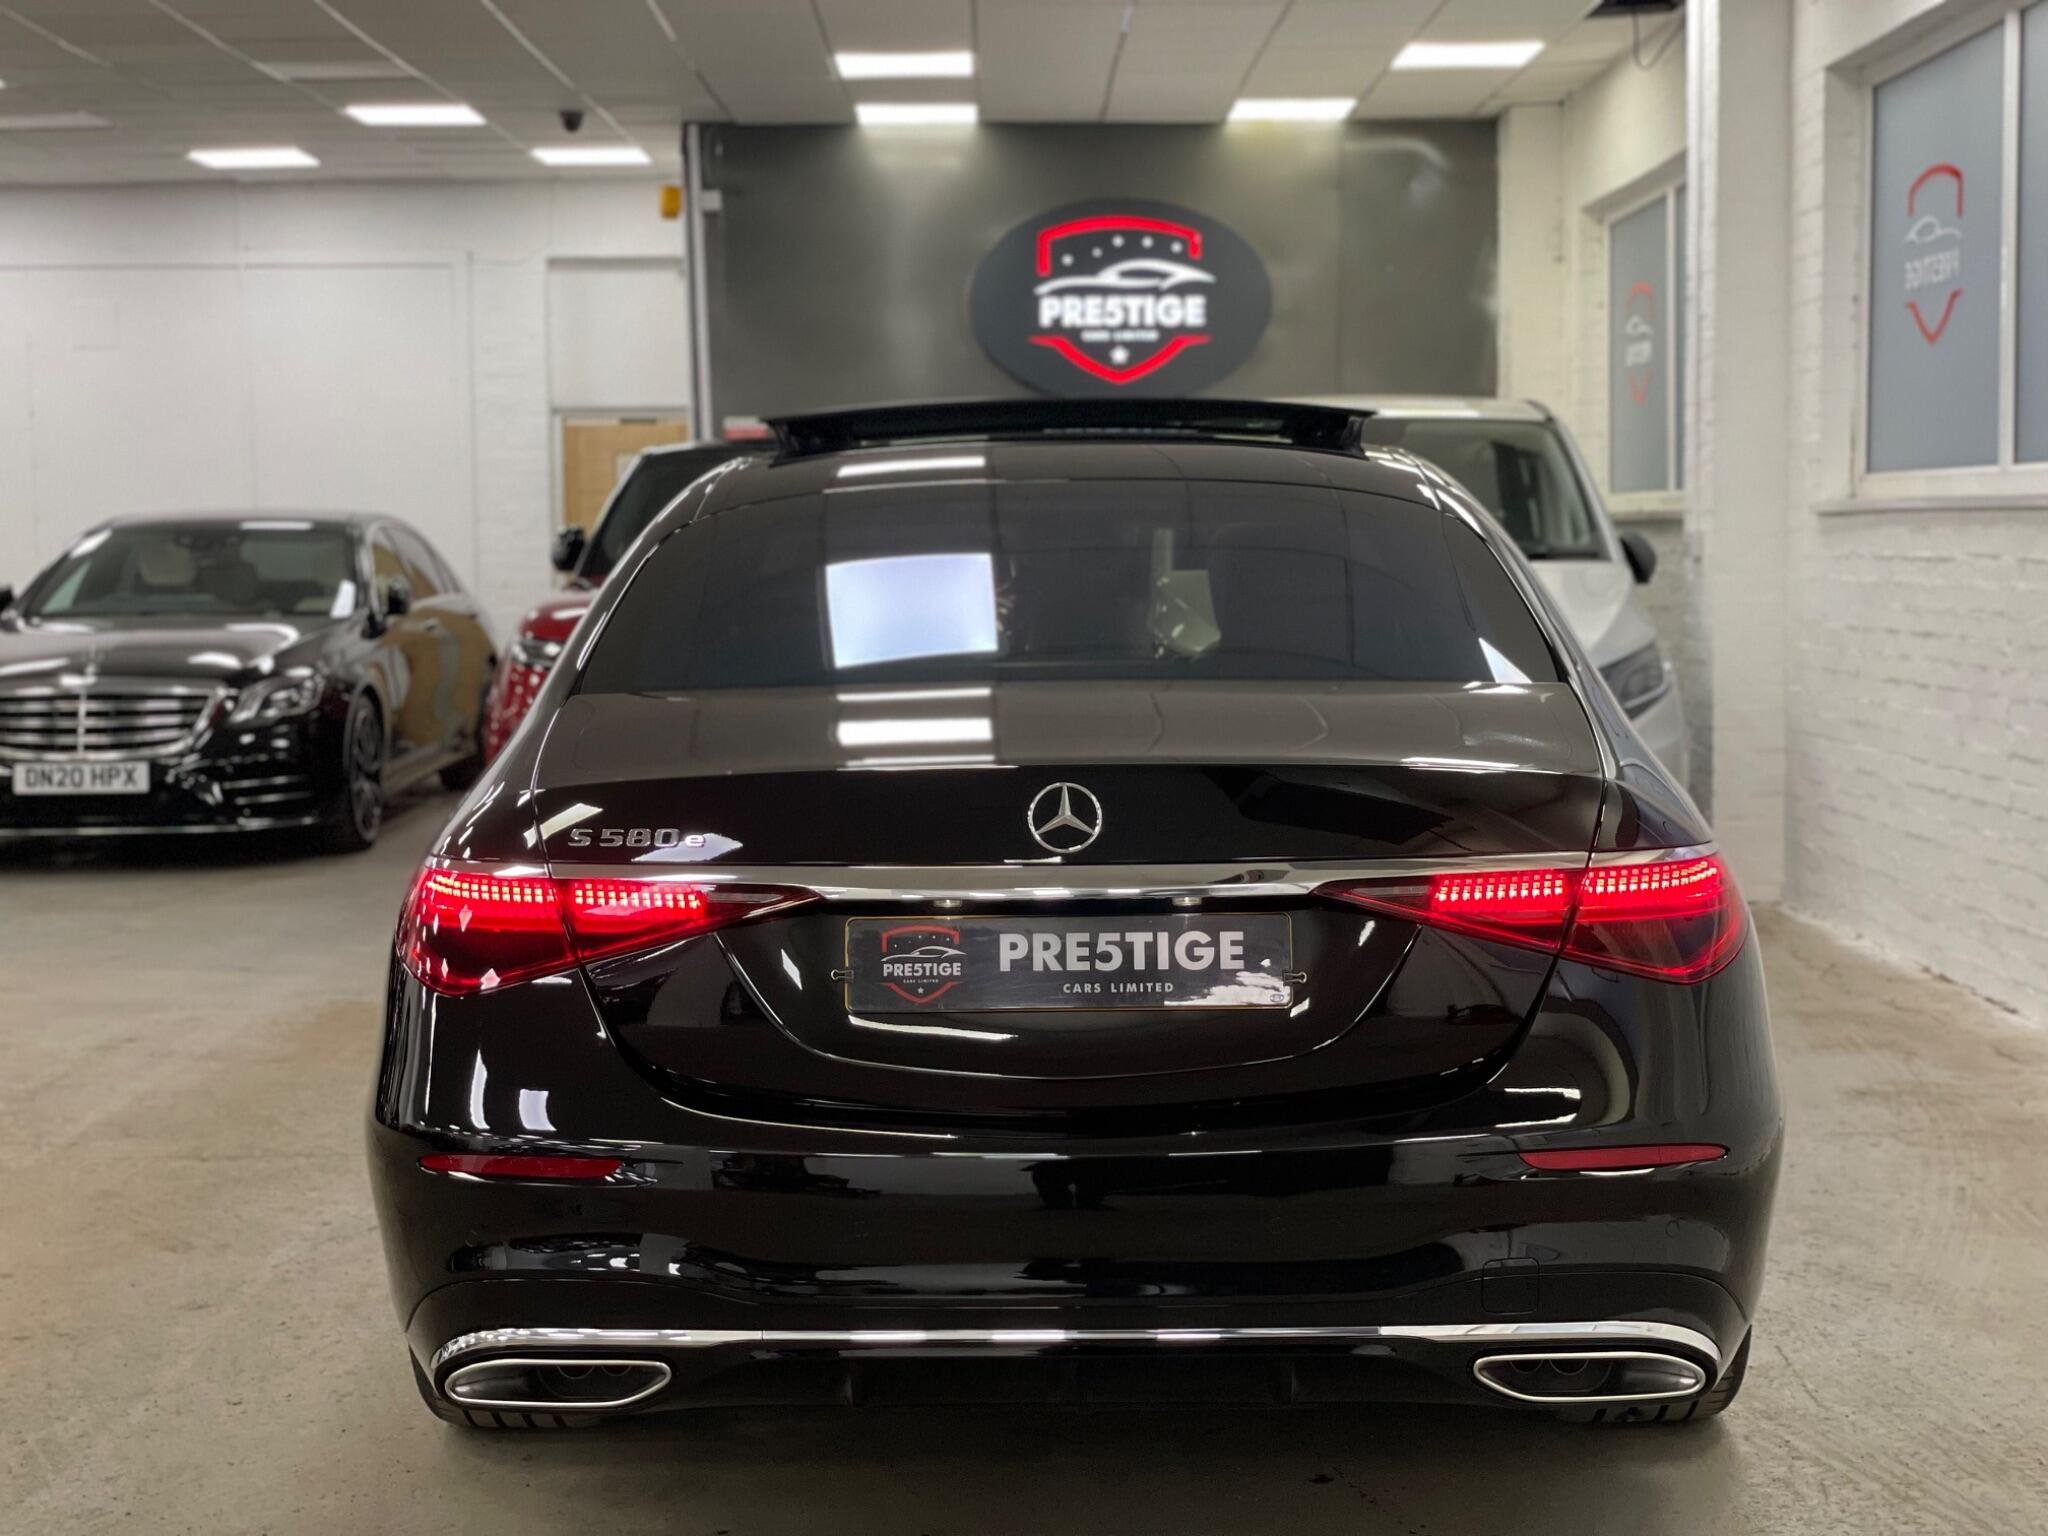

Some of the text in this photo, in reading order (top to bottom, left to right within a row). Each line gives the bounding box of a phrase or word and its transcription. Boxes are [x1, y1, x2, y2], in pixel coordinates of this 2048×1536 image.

[25, 765, 137, 788] DN20 HPX
[1063, 982, 1174, 993] CARS LIMITED
